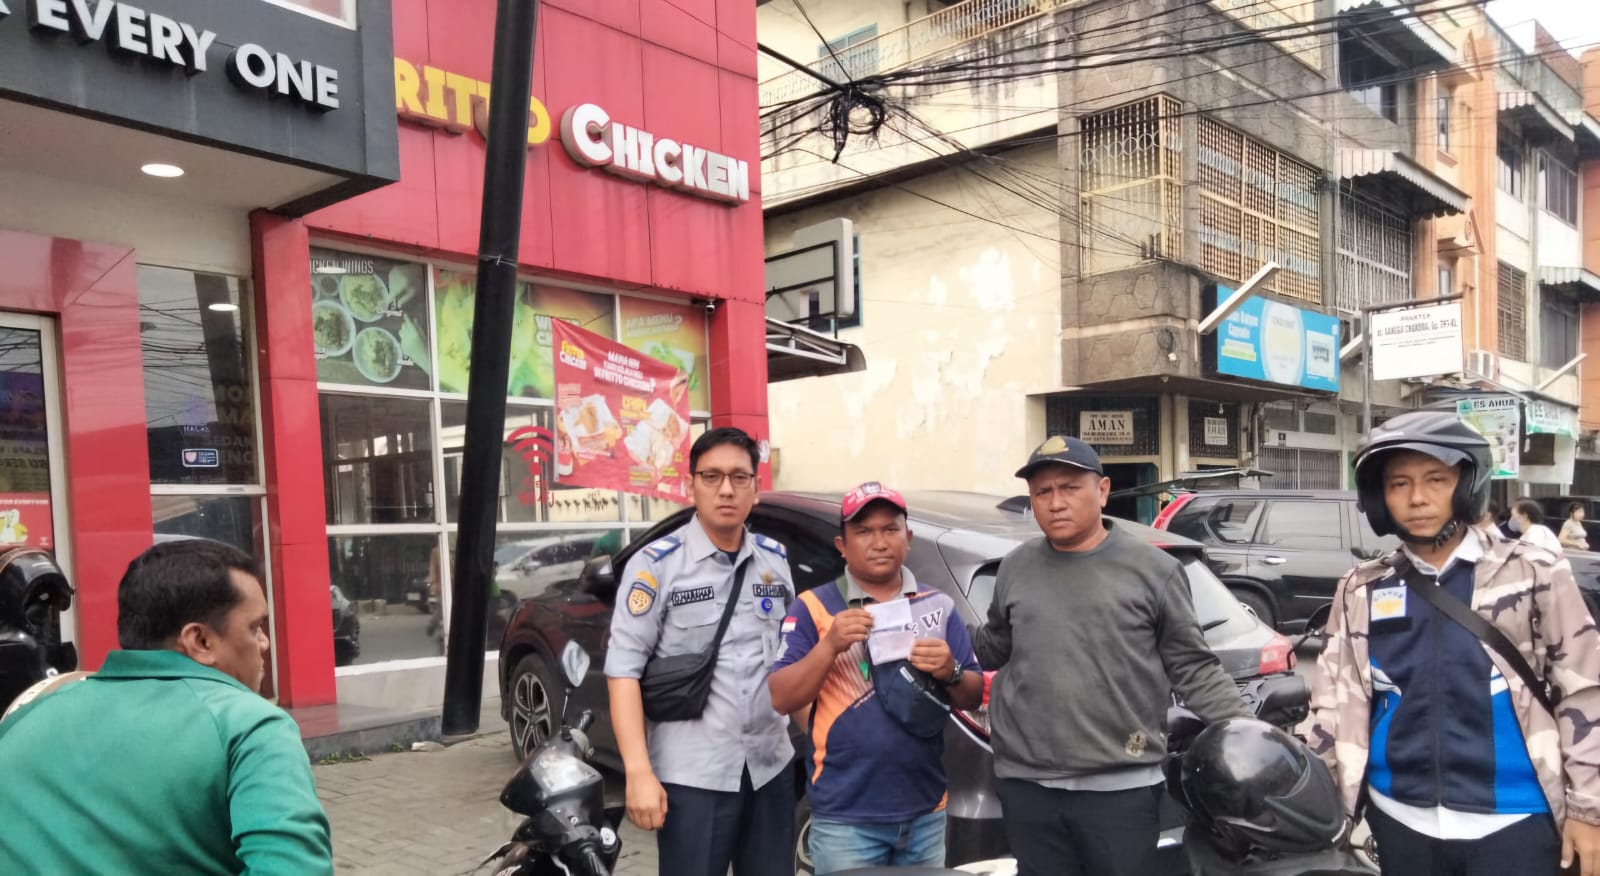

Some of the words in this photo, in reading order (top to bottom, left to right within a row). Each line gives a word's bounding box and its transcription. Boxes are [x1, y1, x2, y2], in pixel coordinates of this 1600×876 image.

[35, 0, 217, 71] EVERY
[233, 43, 339, 108] ONE
[568, 103, 749, 201] CHICKEN
[1088, 419, 1125, 431] AMAN
[920, 607, 943, 631] W
